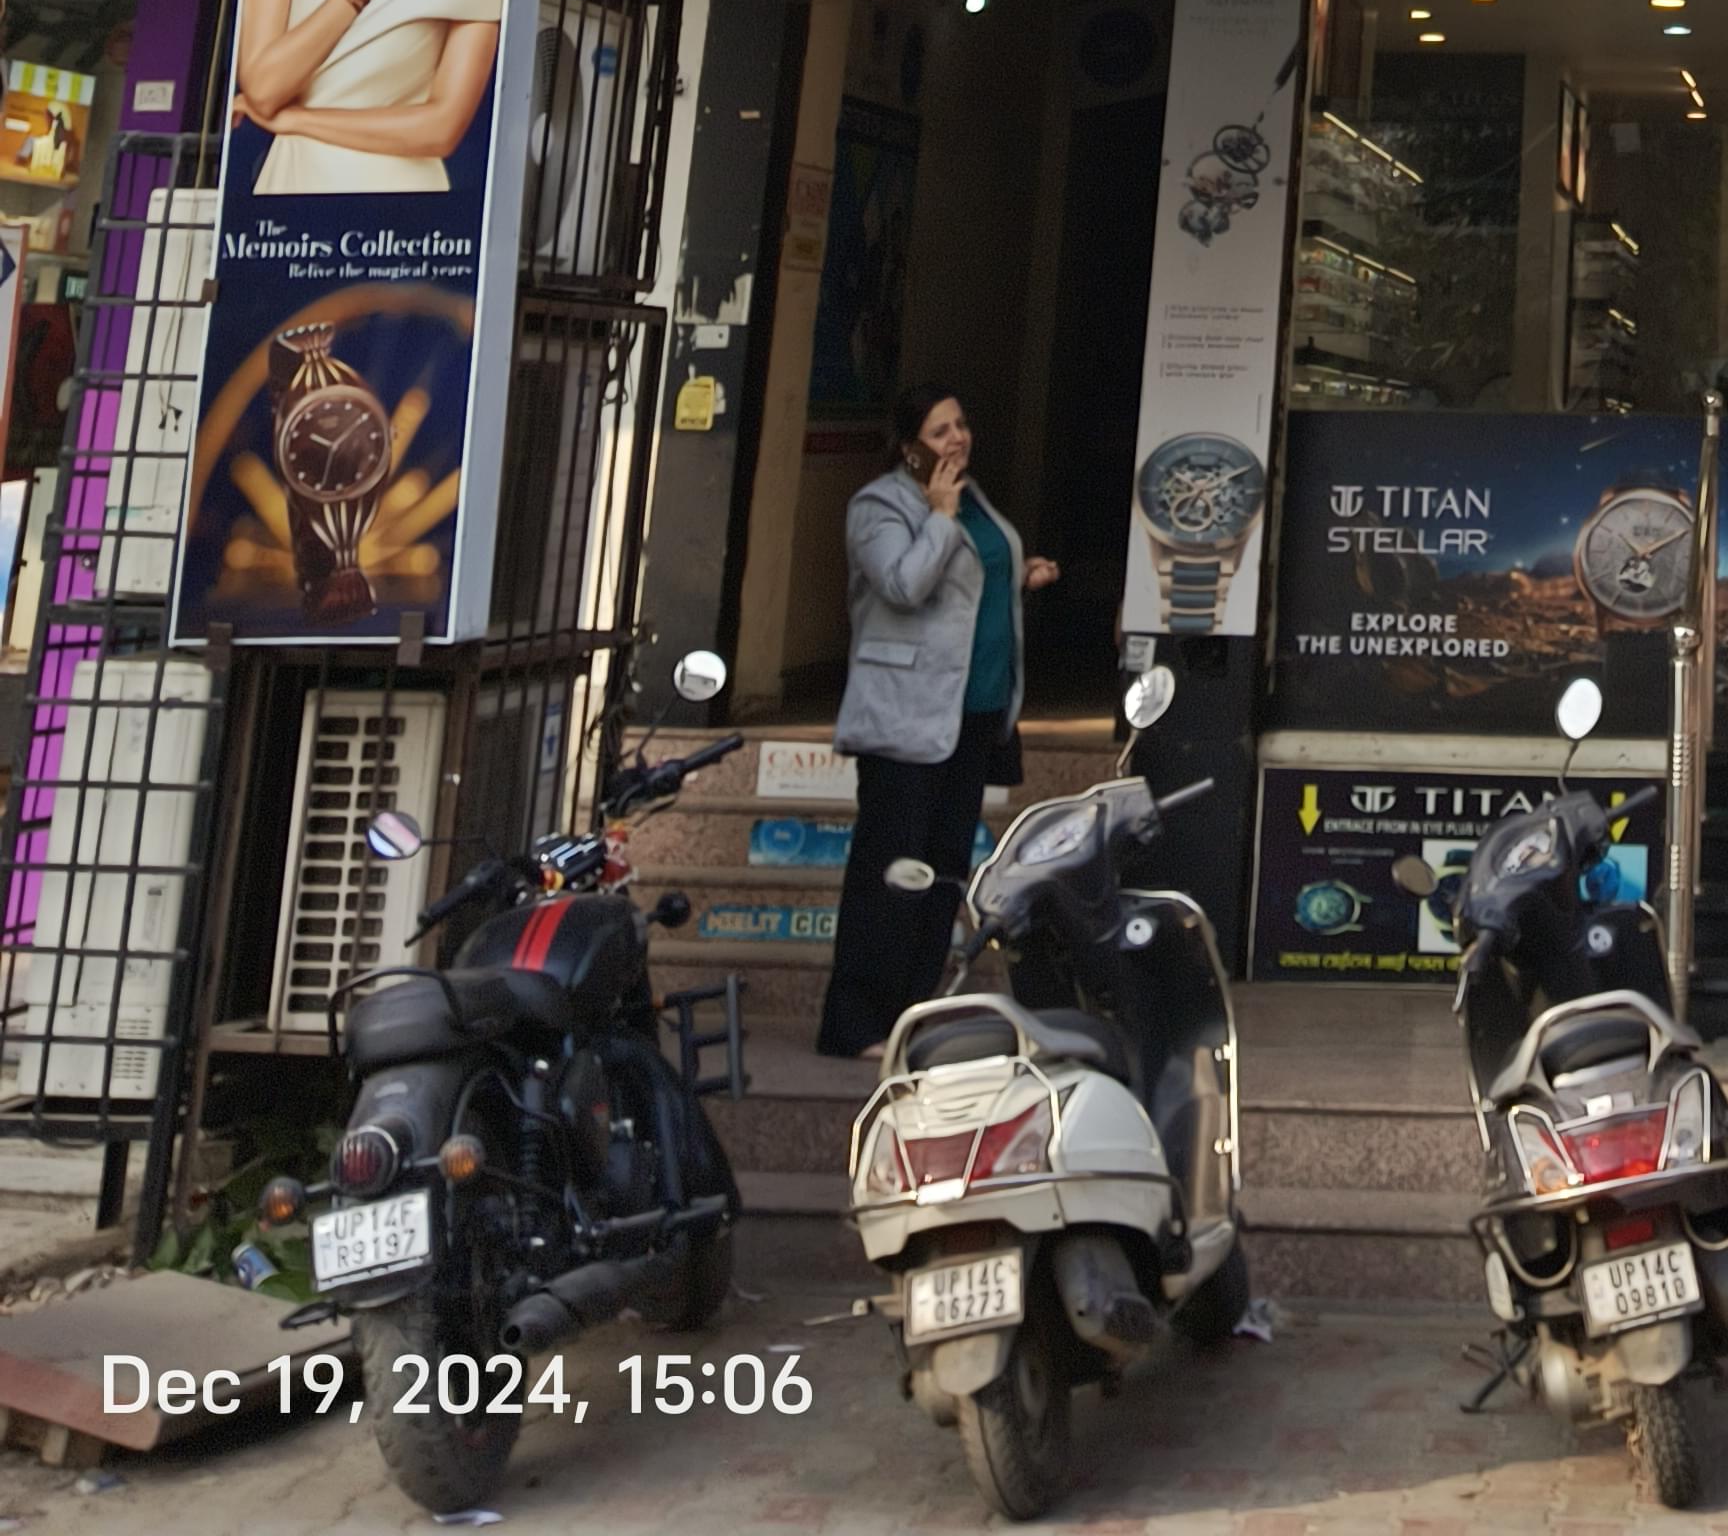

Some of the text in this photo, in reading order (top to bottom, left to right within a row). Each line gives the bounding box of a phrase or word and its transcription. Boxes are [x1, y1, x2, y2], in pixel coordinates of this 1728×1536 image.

[222, 230, 472, 260] Memoirs Collection
[1376, 485, 1492, 519] TITAN
[1327, 526, 1489, 556] STELLAR
[1351, 612, 1458, 634] EXPLORE
[1296, 634, 1511, 657] THE UNEXPLORED
